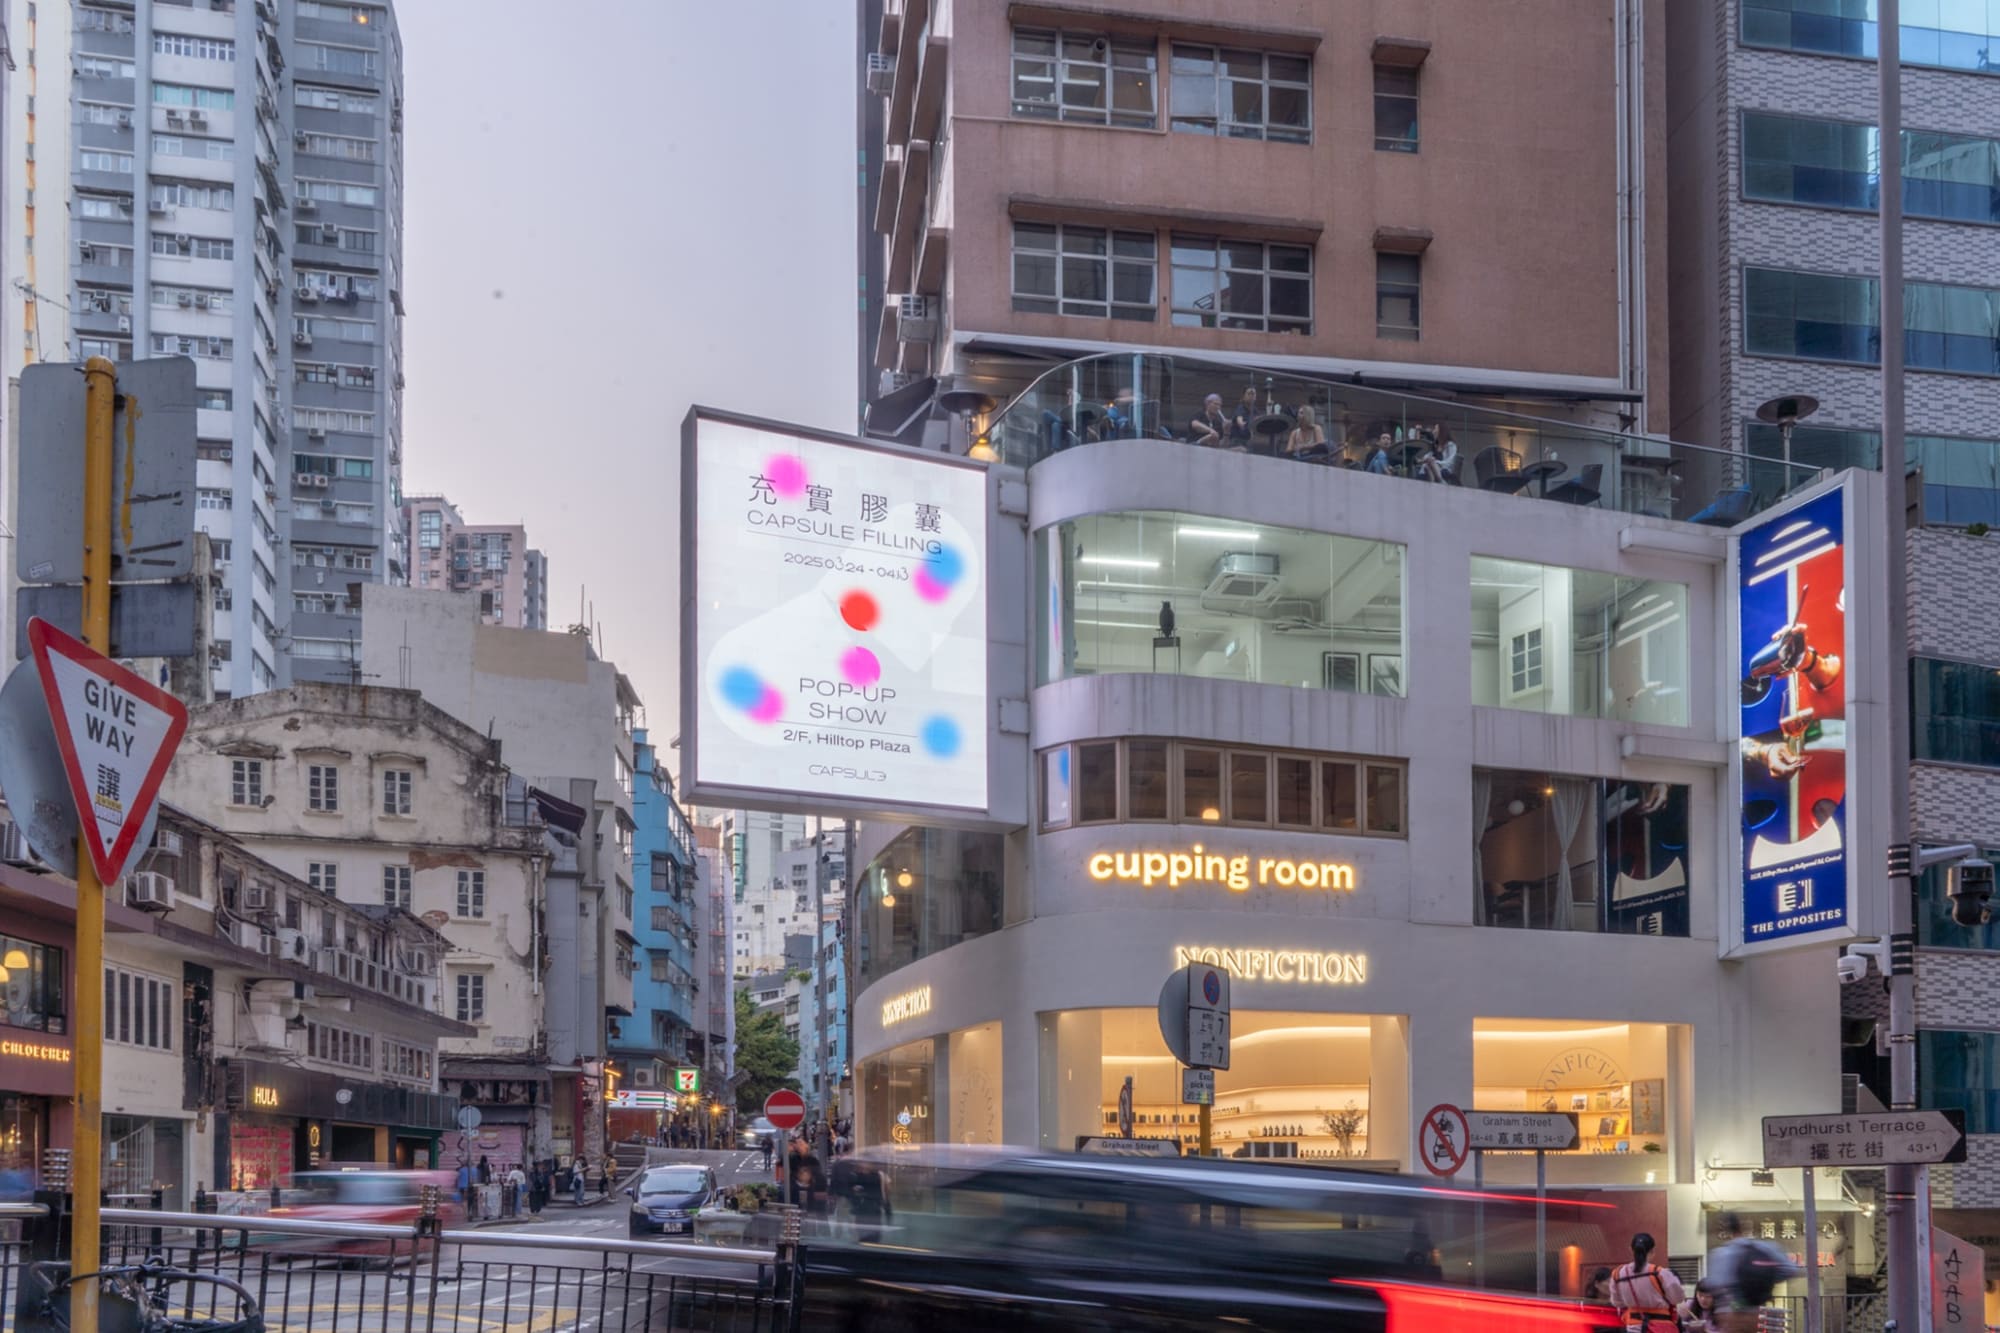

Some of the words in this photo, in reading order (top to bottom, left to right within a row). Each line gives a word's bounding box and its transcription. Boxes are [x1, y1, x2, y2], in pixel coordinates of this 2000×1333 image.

[748, 474, 942, 534] 充實膠囊
[747, 510, 855, 541] CAPSULE
[863, 529, 942, 556] FILLING
[84, 679, 137, 727] GIVE
[800, 678, 896, 703] POP-UP
[809, 702, 887, 725] SHOW
[86, 713, 135, 757] WAY
[783, 730, 812, 745] 2/F,
[817, 734, 865, 749] Hilltop
[870, 739, 911, 753] Plaza
[97, 763, 121, 801] 讓
[1089, 844, 1250, 891] cupping
[1259, 857, 1355, 889] room
[1752, 922, 1774, 934] THE
[1777, 909, 1841, 929] OPPOSITES
[255, 1086, 279, 1106] HULA
[1483, 1116, 1520, 1126] Graham
[1523, 1116, 1552, 1127] Street
[1768, 1121, 1851, 1139] Lyndhurst
[1858, 1119, 1926, 1132] Terrace
[1103, 1140, 1132, 1149] Graham
[1136, 1142, 1160, 1150] Street
[1810, 1141, 1883, 1160] 擺花街
